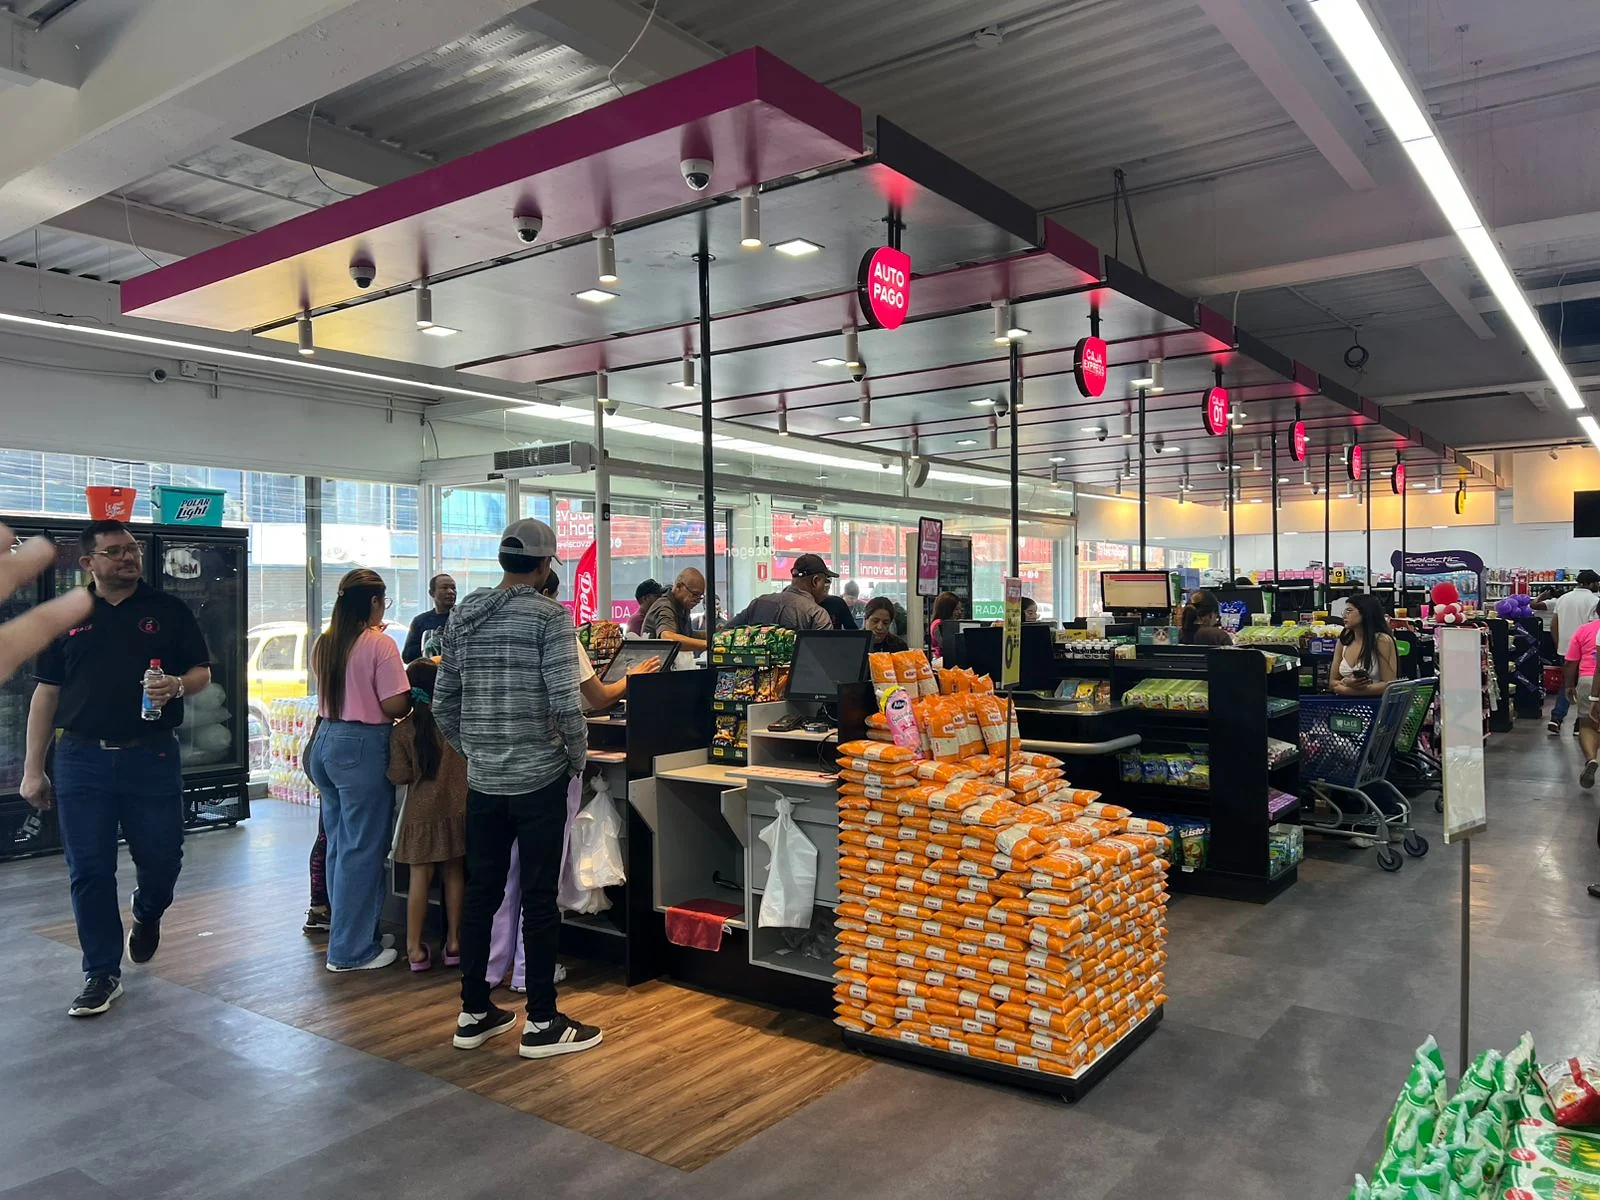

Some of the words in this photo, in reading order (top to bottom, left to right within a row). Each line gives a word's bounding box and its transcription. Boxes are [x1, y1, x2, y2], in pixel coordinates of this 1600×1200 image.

[874, 261, 905, 288] AUTO
[873, 282, 905, 309] PAGO
[1213, 405, 1223, 424] 01
[181, 498, 211, 507] POLAR
[175, 505, 209, 520] Light
[860, 562, 906, 577] innovacin
[975, 605, 1005, 615] RADA
